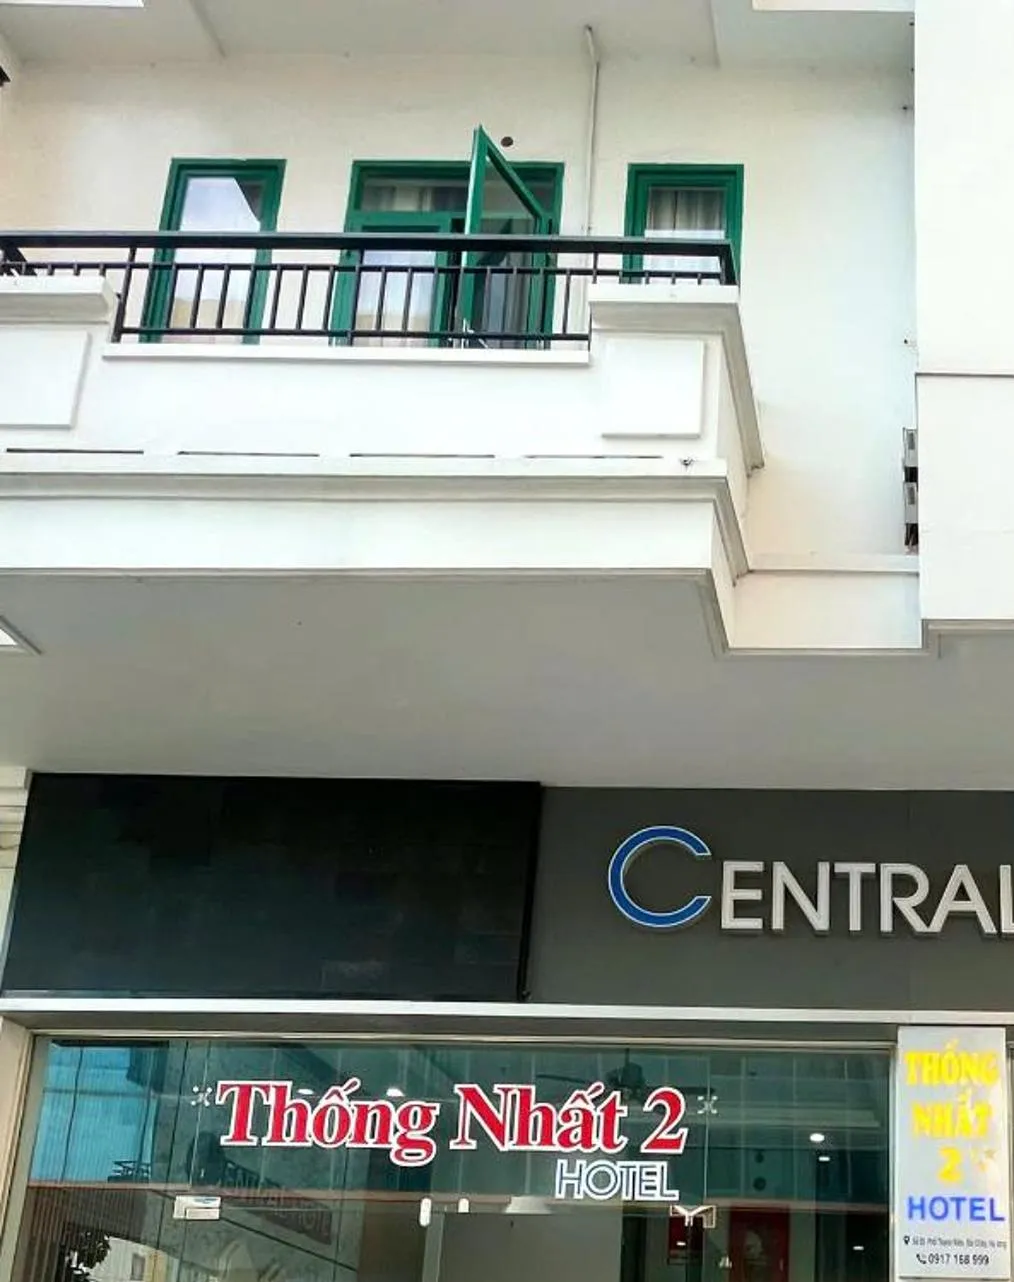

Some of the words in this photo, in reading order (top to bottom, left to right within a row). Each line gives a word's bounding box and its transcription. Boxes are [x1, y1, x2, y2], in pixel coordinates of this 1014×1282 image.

[216, 1078, 439, 1166] Thống
[450, 1082, 629, 1154] Nhất
[640, 1087, 689, 1155] 2
[555, 1160, 679, 1200] HOTEL
[937, 1146, 963, 1184] 2
[907, 1196, 1005, 1221] HOTEL
